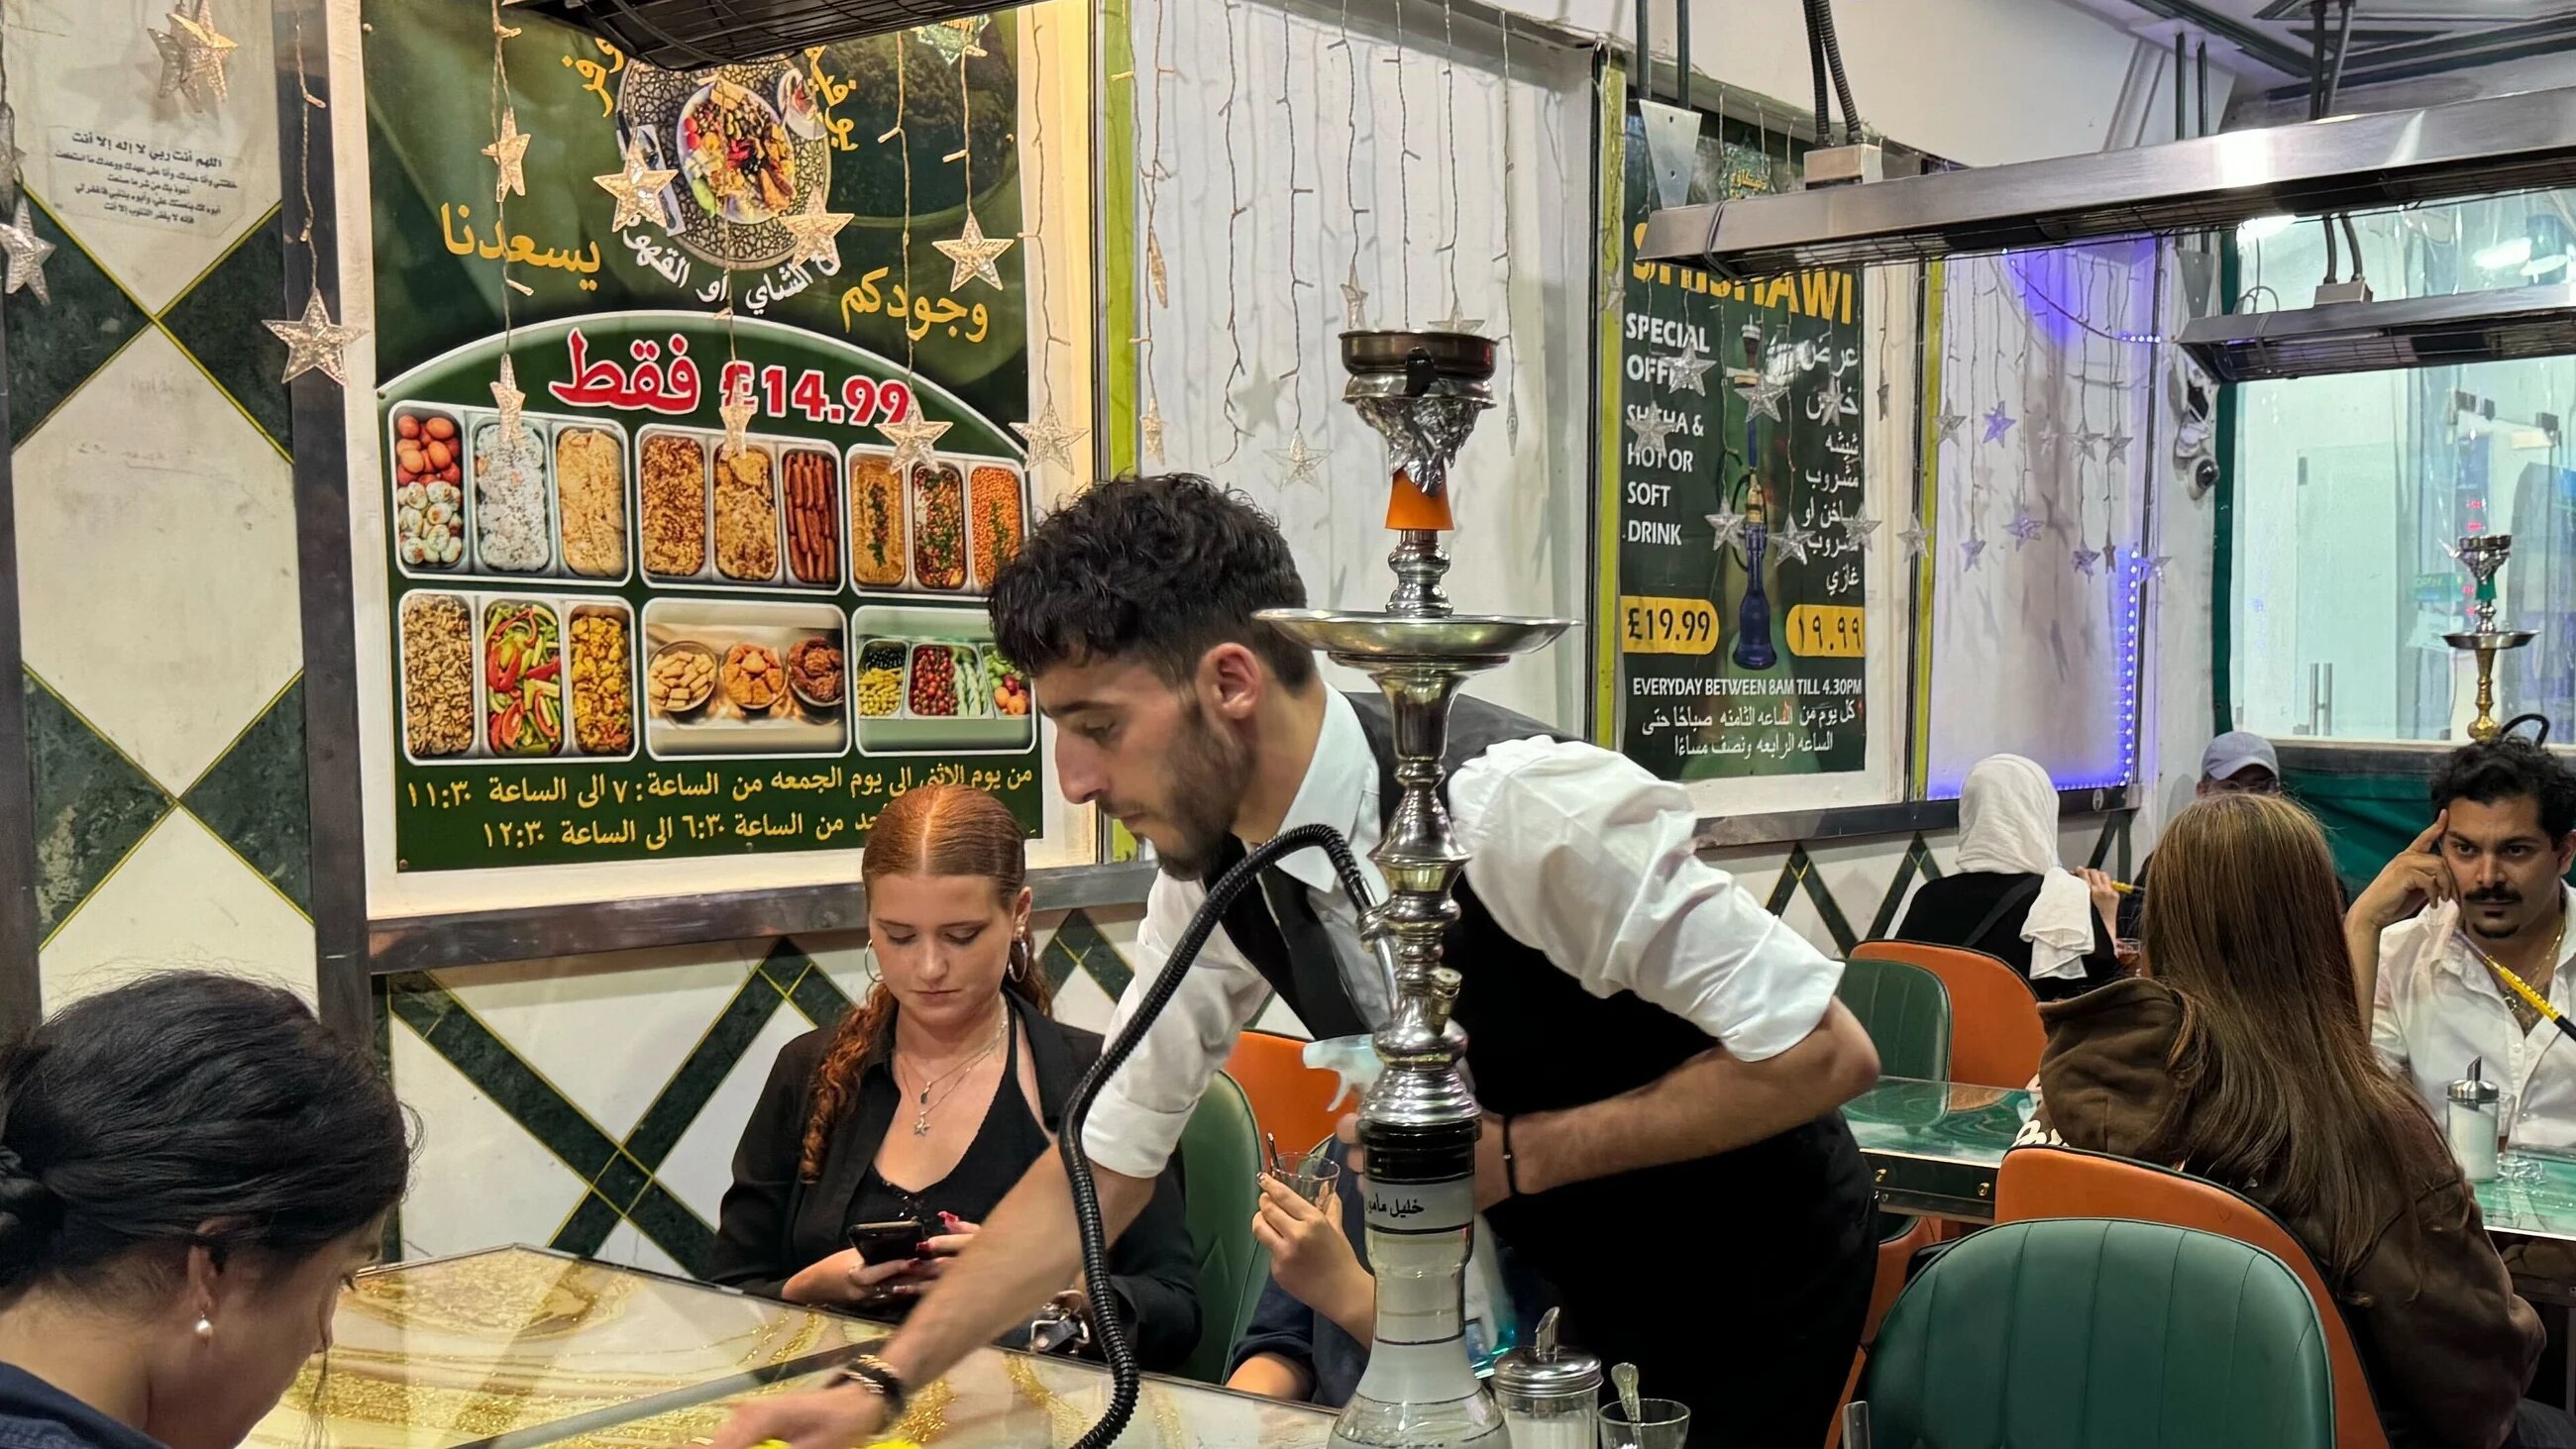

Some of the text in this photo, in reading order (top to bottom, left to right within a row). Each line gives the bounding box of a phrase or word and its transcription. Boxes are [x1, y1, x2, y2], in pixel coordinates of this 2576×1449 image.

[71, 131, 93, 144] أنت
[96, 136, 112, 151] إلا
[115, 141, 133, 155] إله
[135, 143, 147, 155] لا
[172, 150, 193, 161] أنت
[195, 156, 223, 168] اللهم
[440, 201, 989, 343] وجودكم يسعدنا
[696, 267, 729, 303] أو
[745, 260, 813, 315] الشاي
[1625, 312, 1710, 354] SPECIAL
[1800, 338, 1859, 377] عرض
[549, 327, 912, 428] £14.99 فقط
[1692, 414, 1704, 437] &
[1667, 448, 1694, 472] OR
[1805, 466, 1860, 493] مشروب
[1627, 481, 1672, 507] SOFT
[1627, 519, 1683, 546] DRINK
[1825, 563, 1861, 596] غازي
[1627, 607, 1711, 643] £19.99
[1797, 614, 1862, 652] ١٩.٩٩
[1632, 677, 1863, 696] EVERYDAY BETWEEN 8AM TILL 4.30PM
[1719, 705, 1755, 727] الثامنه
[1758, 702, 1793, 726] الساعه
[1798, 704, 1817, 727] من
[1819, 708, 1838, 728] يوم
[1839, 698, 1856, 723] كل
[1711, 735, 1752, 760] ونصف
[1756, 731, 1794, 760] الرابعه
[1797, 730, 1834, 752] الساعه
[488, 776, 567, 803] الساعة
[577, 773, 605, 808] الى
[731, 776, 762, 801] من
[770, 765, 843, 793] الجمعه
[849, 774, 882, 799] يوم
[889, 766, 912, 797] الى
[970, 768, 1001, 792] يوم
[1006, 766, 1032, 790] من
[407, 779, 472, 809] ١١:٣٠
[483, 820, 545, 849] ١٢:٣٠
[560, 819, 636, 846] الساعة
[645, 815, 674, 851] الى
[682, 813, 725, 840] ٦:٣٠
[734, 811, 804, 837] الساعة
[814, 814, 844, 841] من
[1389, 1198, 1425, 1218] خليل
